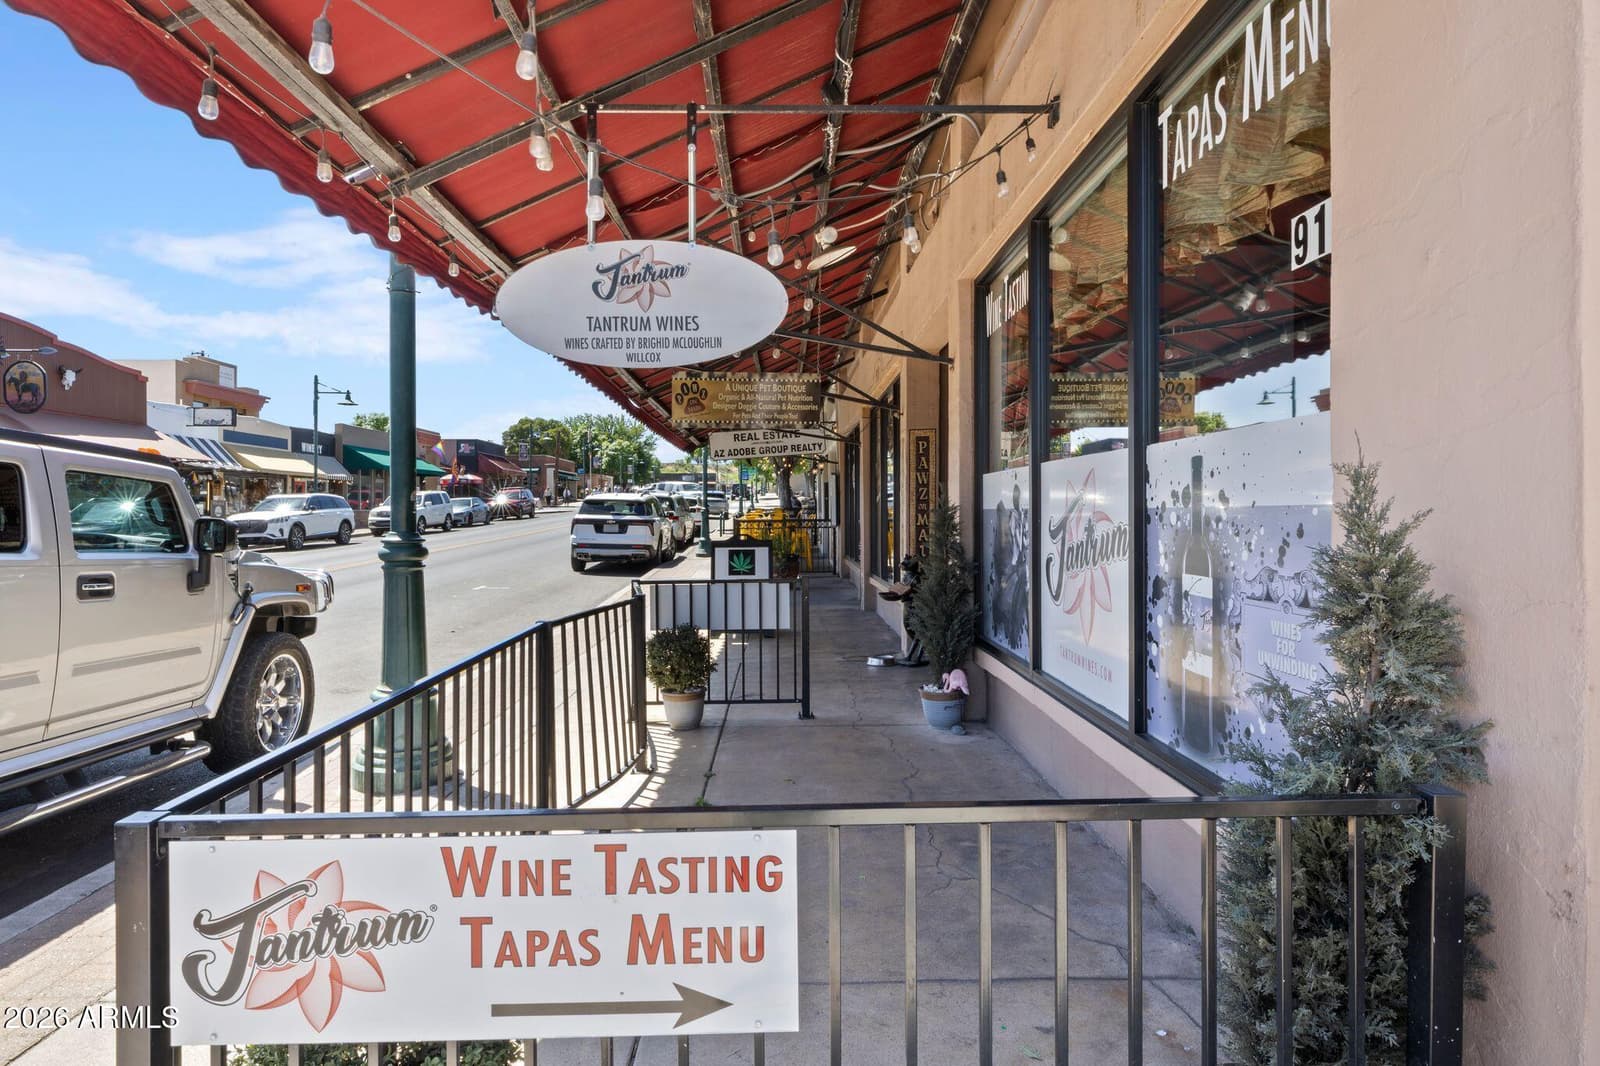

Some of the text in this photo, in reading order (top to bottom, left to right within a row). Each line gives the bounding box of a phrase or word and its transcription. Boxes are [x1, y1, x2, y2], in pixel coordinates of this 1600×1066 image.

[1158, 76, 1227, 190] TAPAS
[592, 253, 688, 302] Tantrum
[985, 269, 1029, 338] WINE TASTIN
[586, 315, 700, 332] TANTRUM WINES
[564, 336, 723, 350] WINES CRAFTED BY BRIGHID MCLOUGHLIN
[625, 352, 661, 363] WILLCOX
[718, 393, 740, 402] Organic
[725, 383, 807, 393] A UNIQUE PET BOUTIQUE
[733, 430, 801, 442] REAL ESTATE
[713, 442, 823, 458] AZ ADOBE GROUP REALTY
[916, 440, 929, 500] PAWZ
[1045, 487, 1128, 605] Tantrum
[1271, 619, 1302, 642] WINES
[1276, 640, 1296, 658] FOR
[1257, 650, 1318, 681] UNWINDING
[440, 843, 784, 898] WINE TASTING
[181, 879, 436, 1007] Tantrum
[459, 912, 766, 969] TAPAS MENU
